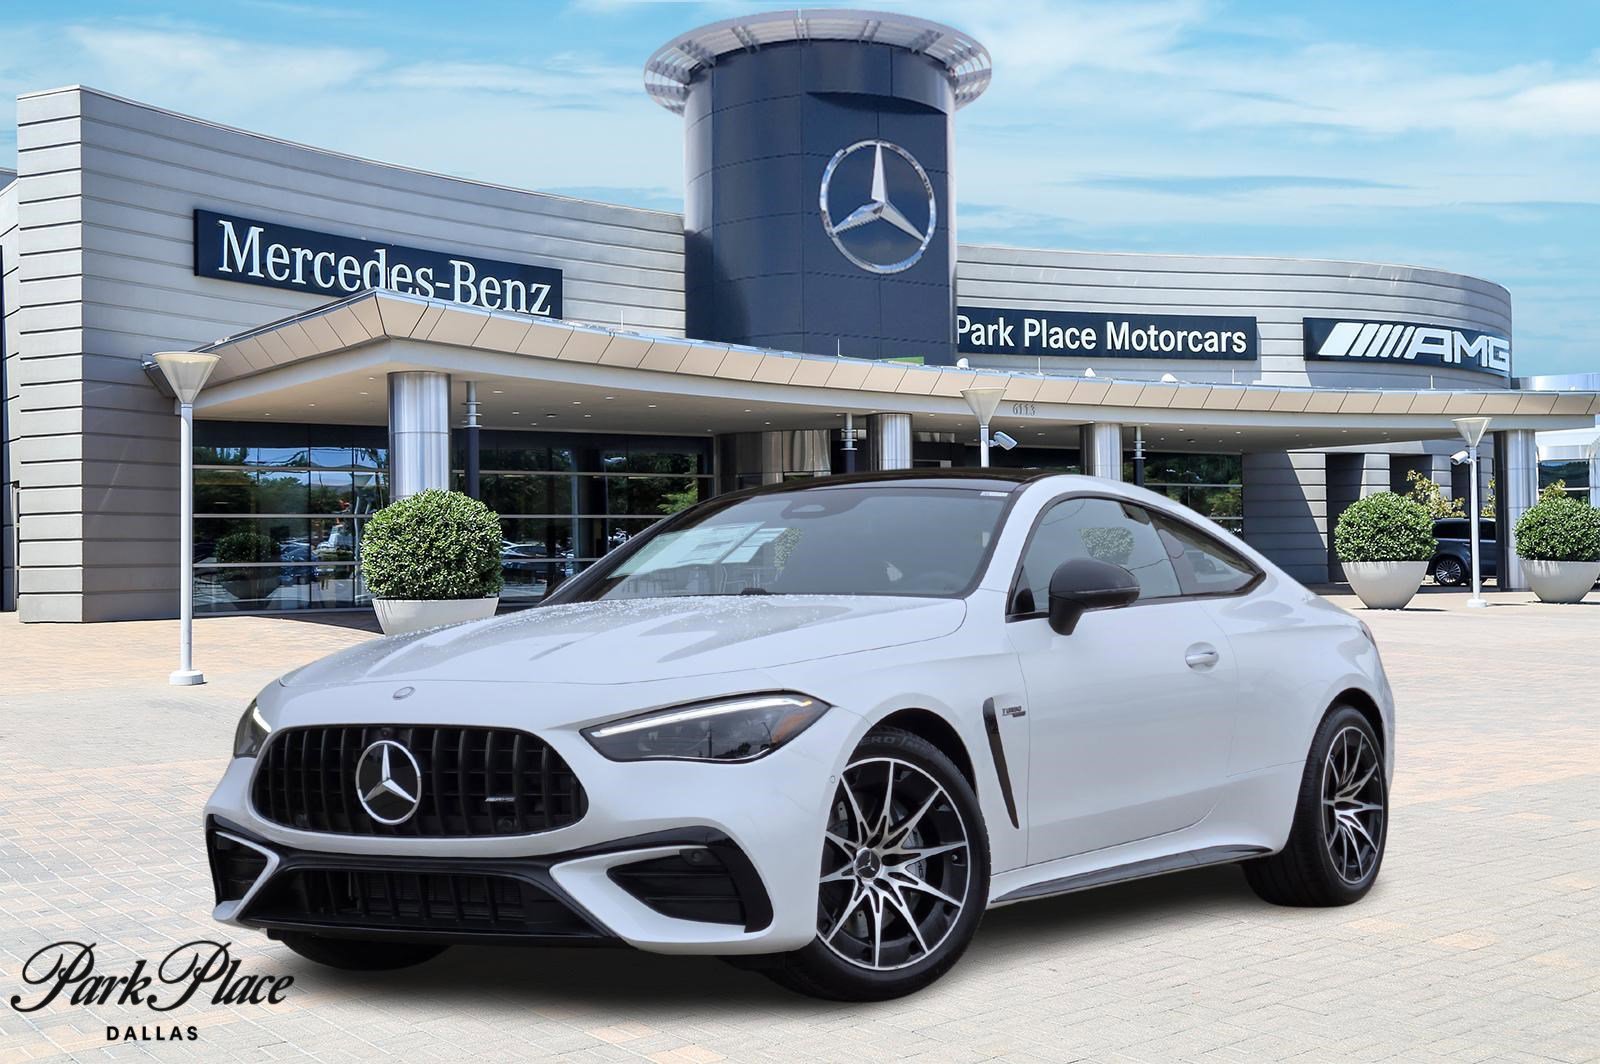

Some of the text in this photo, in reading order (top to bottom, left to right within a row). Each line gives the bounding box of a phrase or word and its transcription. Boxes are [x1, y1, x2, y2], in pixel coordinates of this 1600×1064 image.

[218, 219, 552, 316] Mercedes-Benz
[957, 315, 1248, 353] Park Place Motorcars
[1403, 326, 1510, 372] AMG
